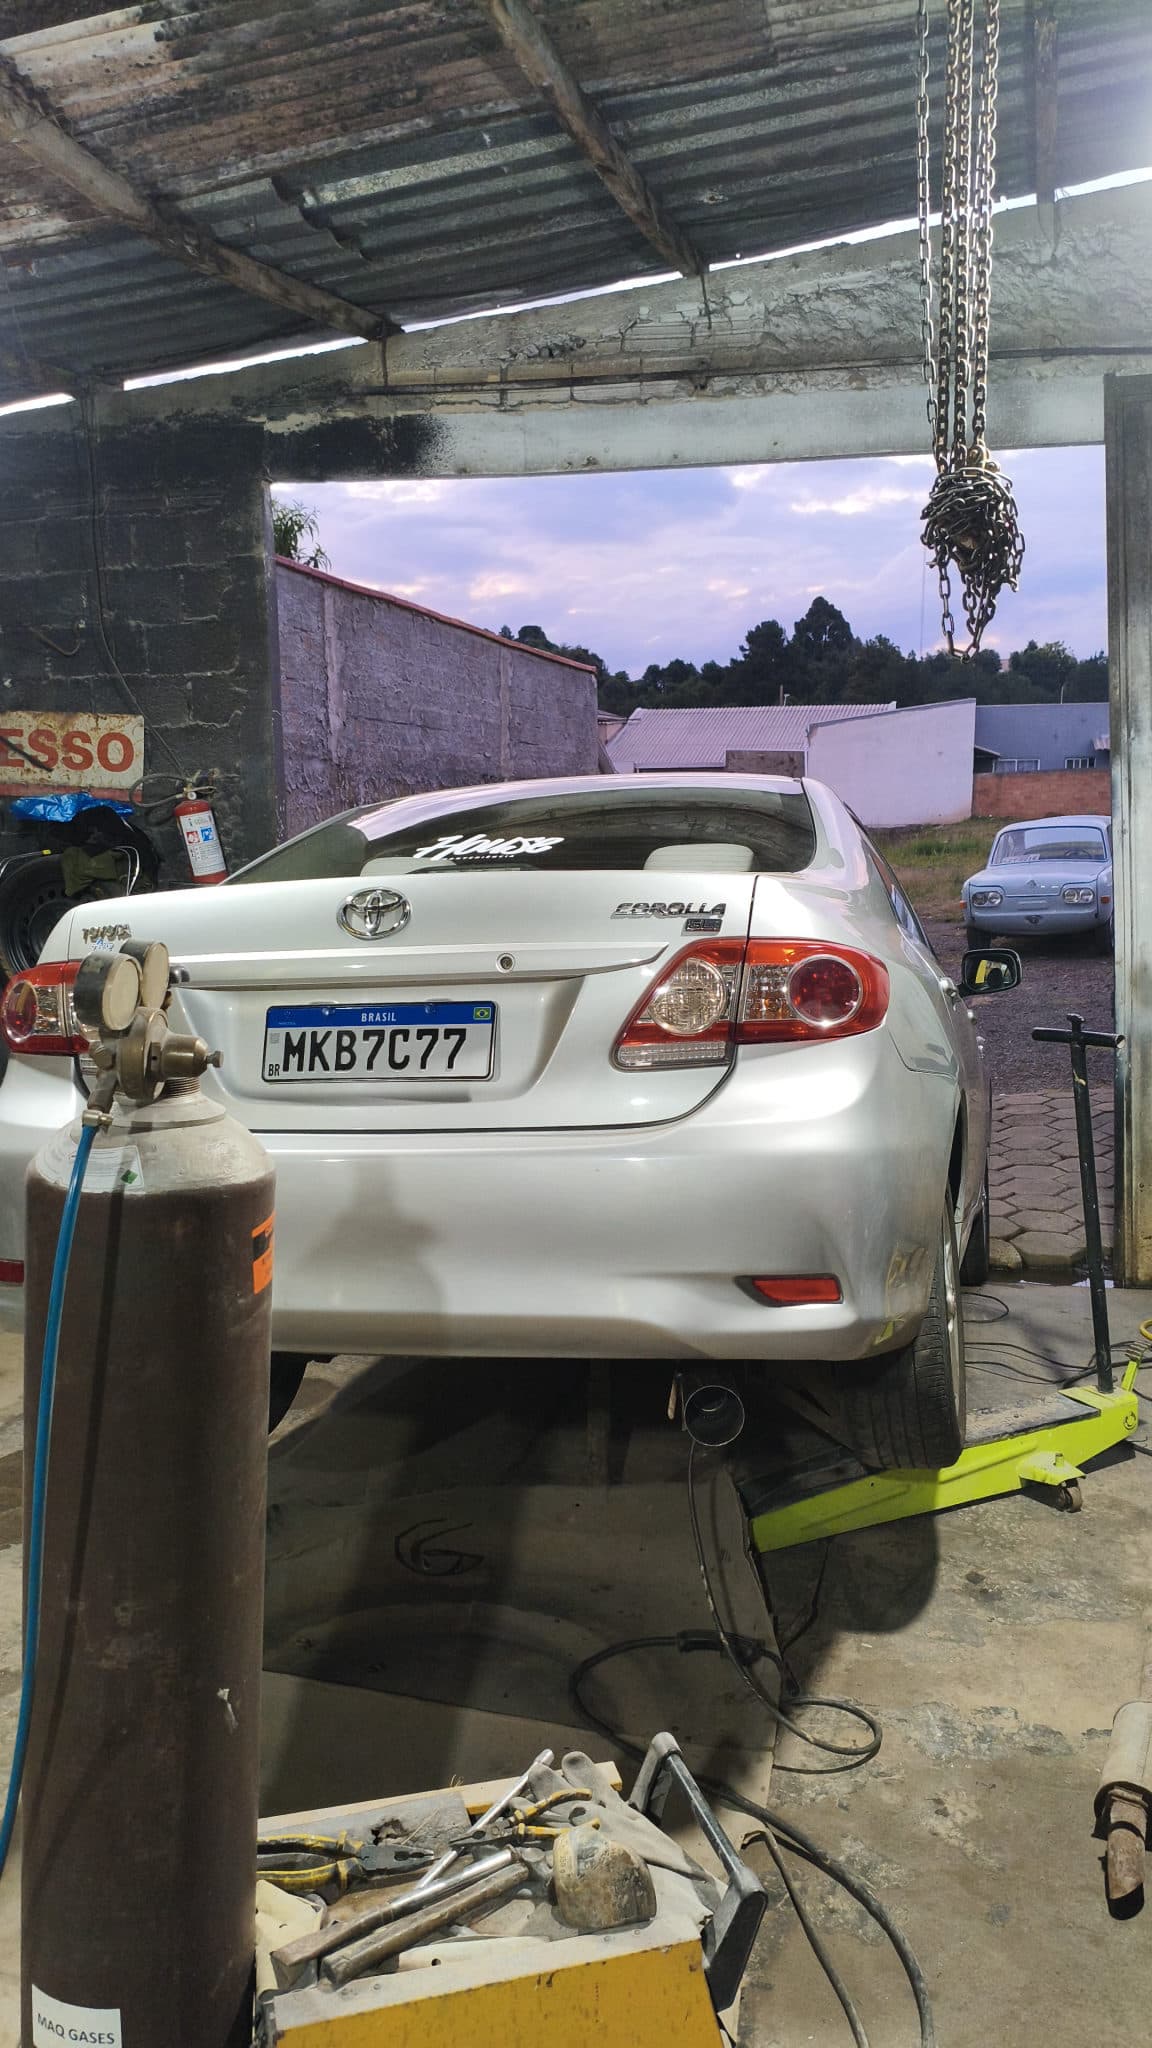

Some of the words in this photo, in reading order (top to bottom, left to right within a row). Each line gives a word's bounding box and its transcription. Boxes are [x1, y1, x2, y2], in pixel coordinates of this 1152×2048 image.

[613, 902, 727, 917] COROLLA
[361, 1011, 396, 1023] BRASIL
[282, 1028, 467, 1072] MKB7C77
[268, 1063, 280, 1077] BR
[37, 2013, 65, 2039] MAQ
[68, 2029, 115, 2045] GASES
